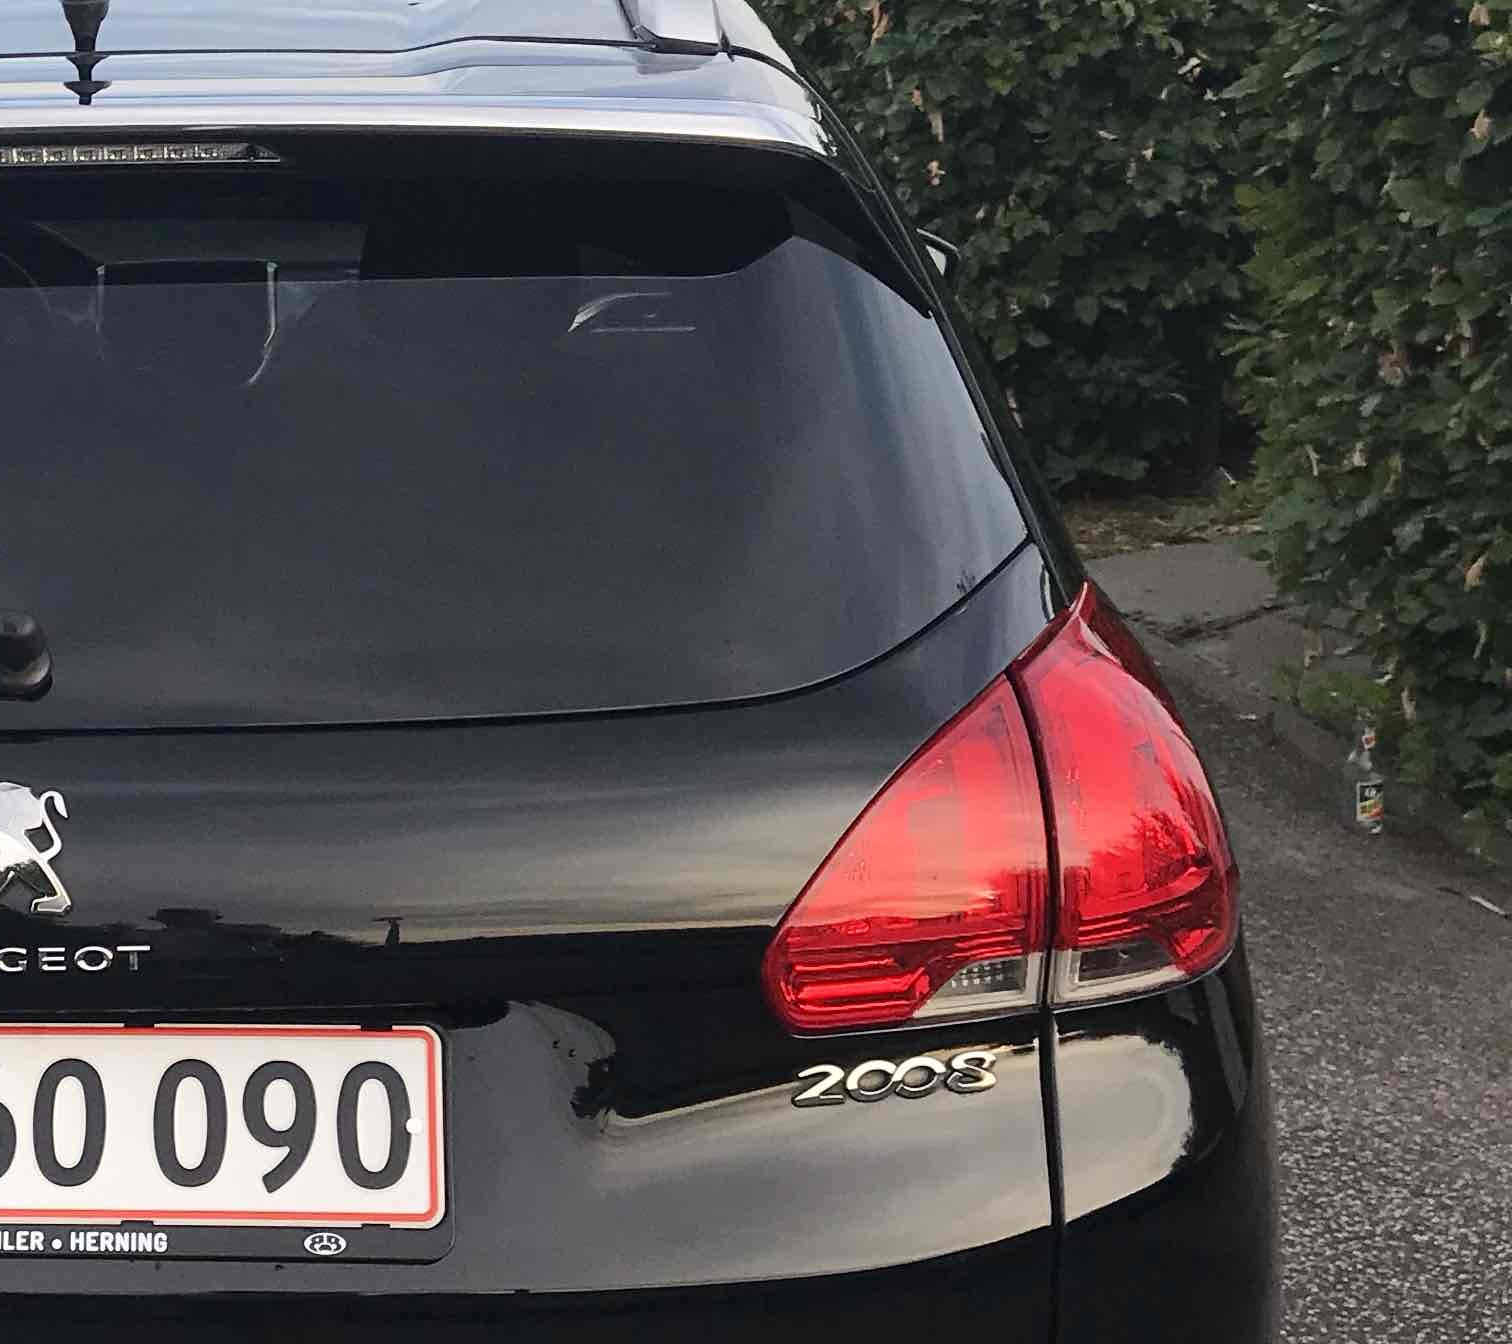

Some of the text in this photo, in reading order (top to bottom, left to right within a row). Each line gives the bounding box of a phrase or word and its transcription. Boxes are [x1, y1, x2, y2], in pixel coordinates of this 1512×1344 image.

[792, 1051, 997, 1107] 2008
[153, 1058, 411, 1194] 090
[70, 1231, 168, 1253] HERNING
